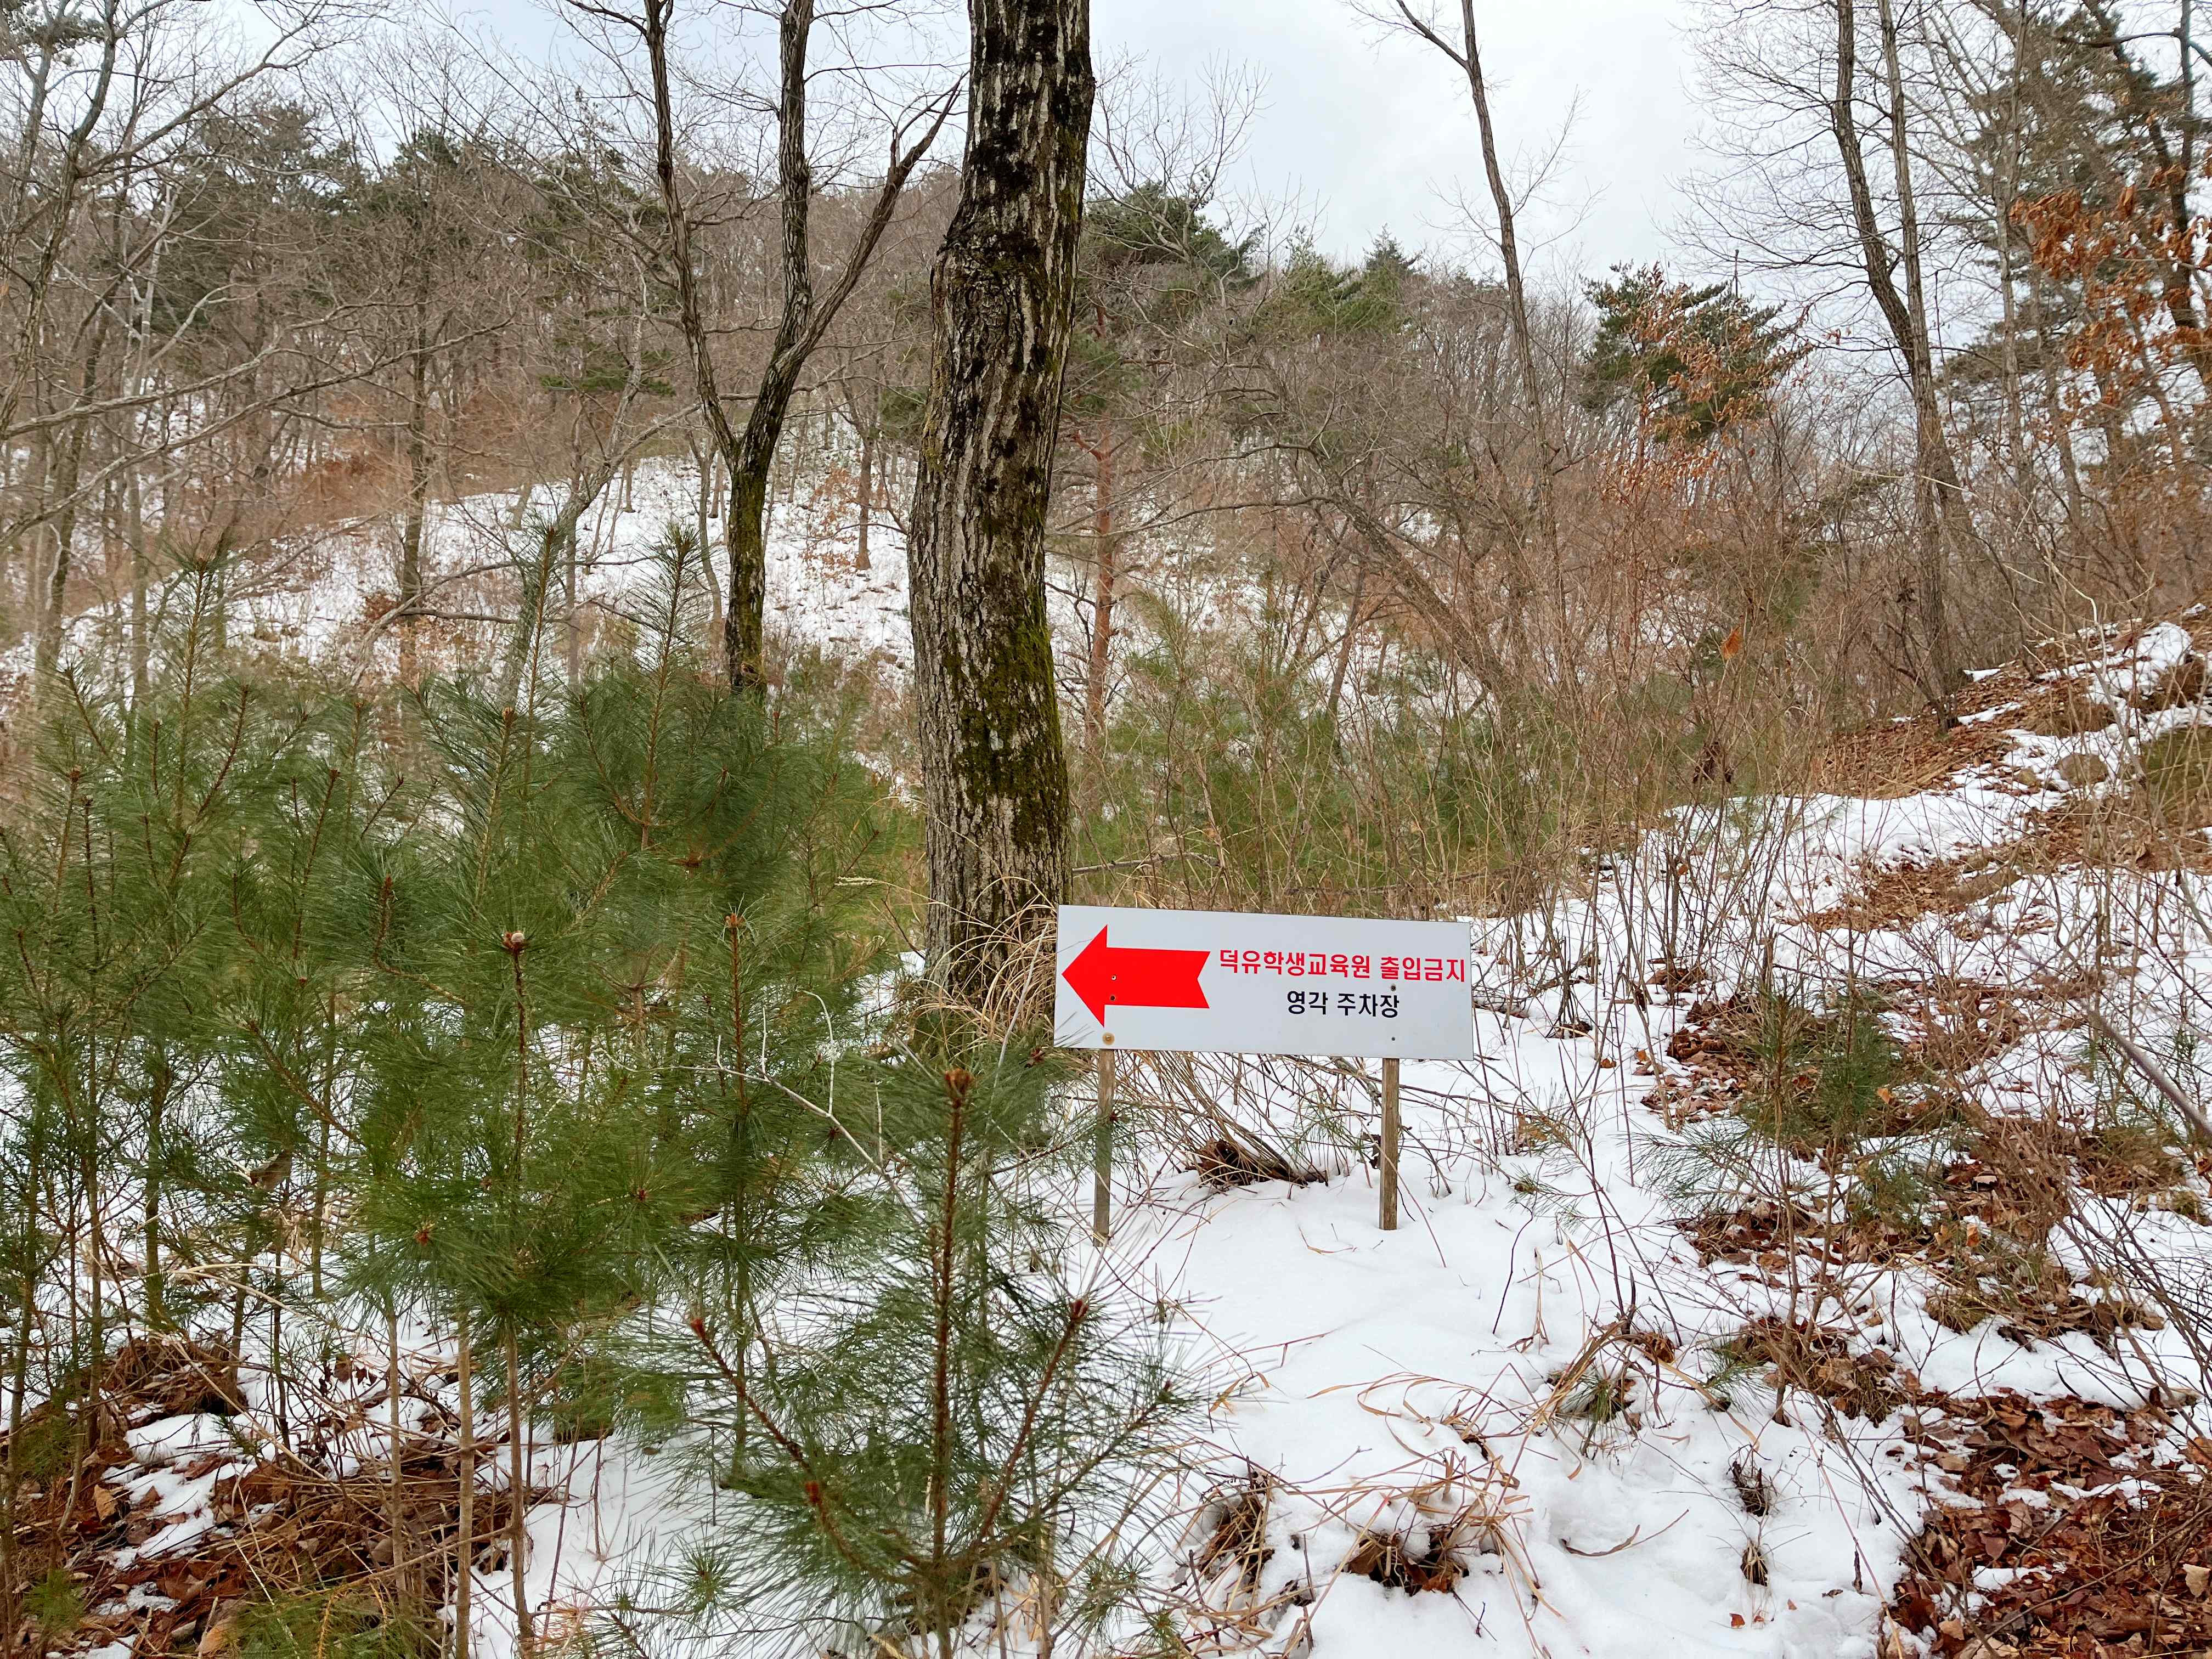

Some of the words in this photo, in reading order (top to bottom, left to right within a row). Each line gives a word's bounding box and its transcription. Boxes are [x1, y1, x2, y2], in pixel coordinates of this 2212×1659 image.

[1220, 950, 1370, 979] 덕유학생교육원
[1380, 956, 1465, 983] 출입금지
[1287, 990, 1328, 1015] 영각
[1337, 993, 1400, 1018] 주차장
